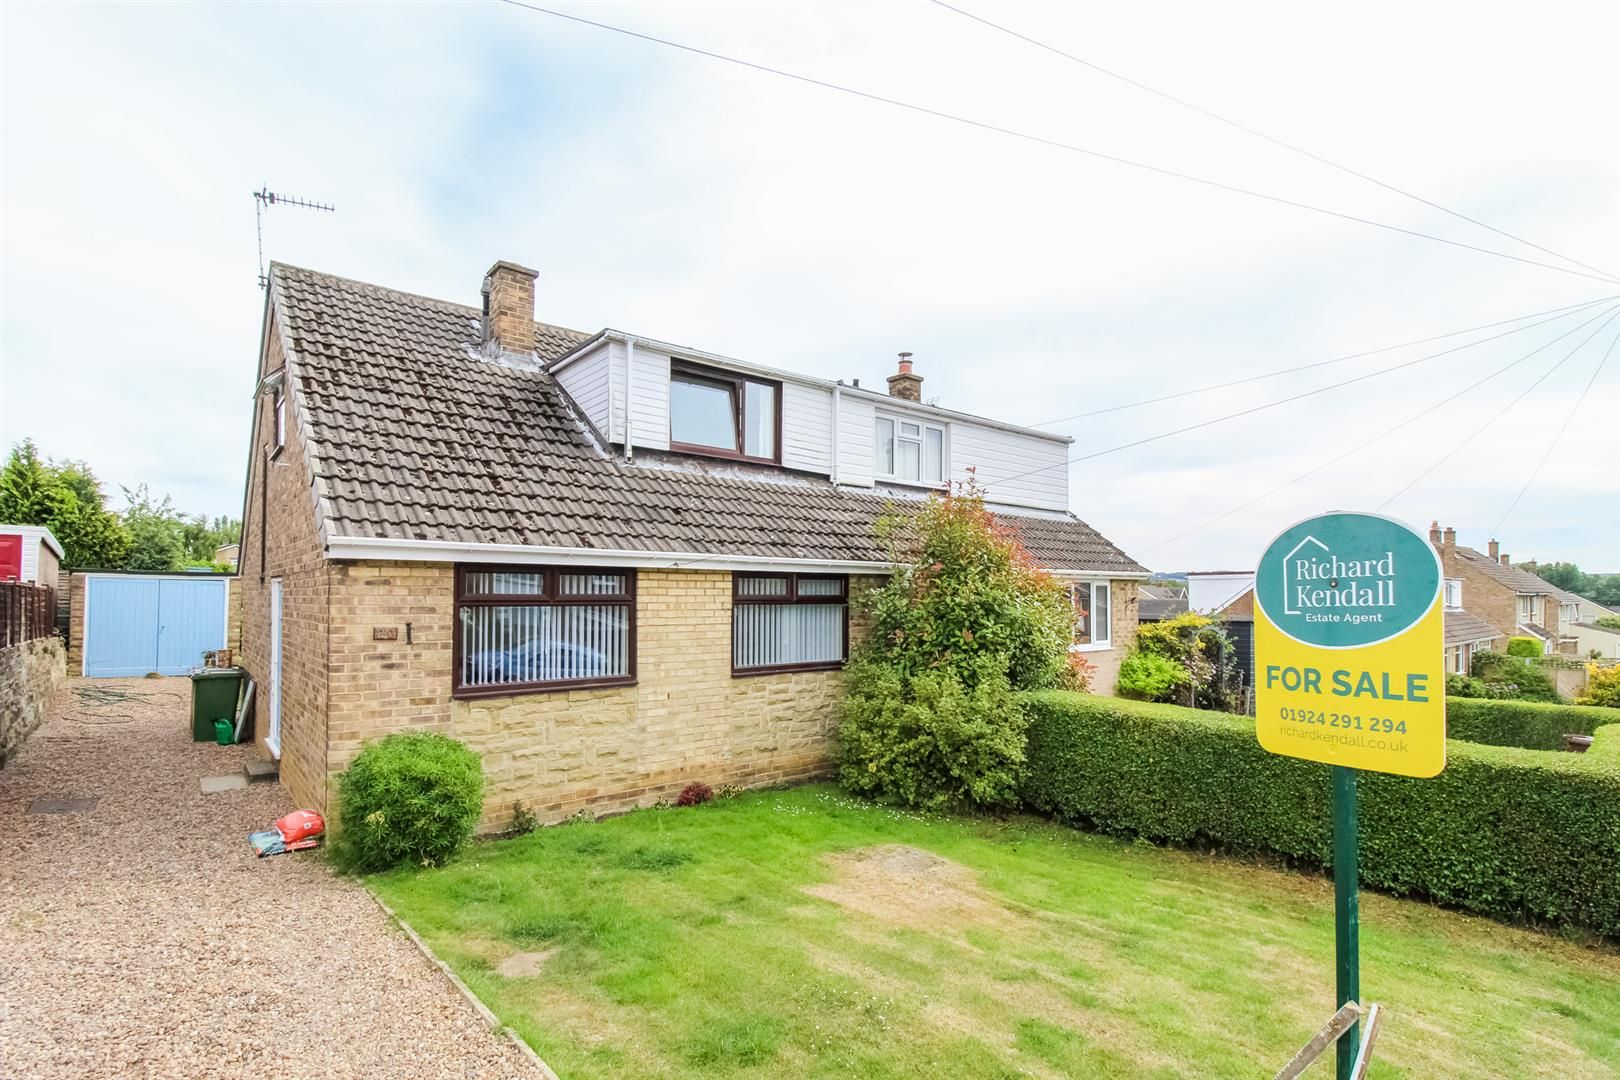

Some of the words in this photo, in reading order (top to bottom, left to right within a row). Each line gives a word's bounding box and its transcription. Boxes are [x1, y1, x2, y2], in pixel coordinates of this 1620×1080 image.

[1296, 552, 1395, 580] Richard
[1296, 580, 1395, 607] Kendall
[1306, 613, 1340, 622] Estate
[1344, 613, 1382, 624] Agent
[1267, 665, 1321, 694] FOR
[1332, 670, 1429, 702] SALE
[1280, 707, 1325, 725] 01924
[1330, 713, 1363, 730] 291
[1369, 718, 1408, 735] 294
[1280, 727, 1408, 753] richardkendall.co.uk
